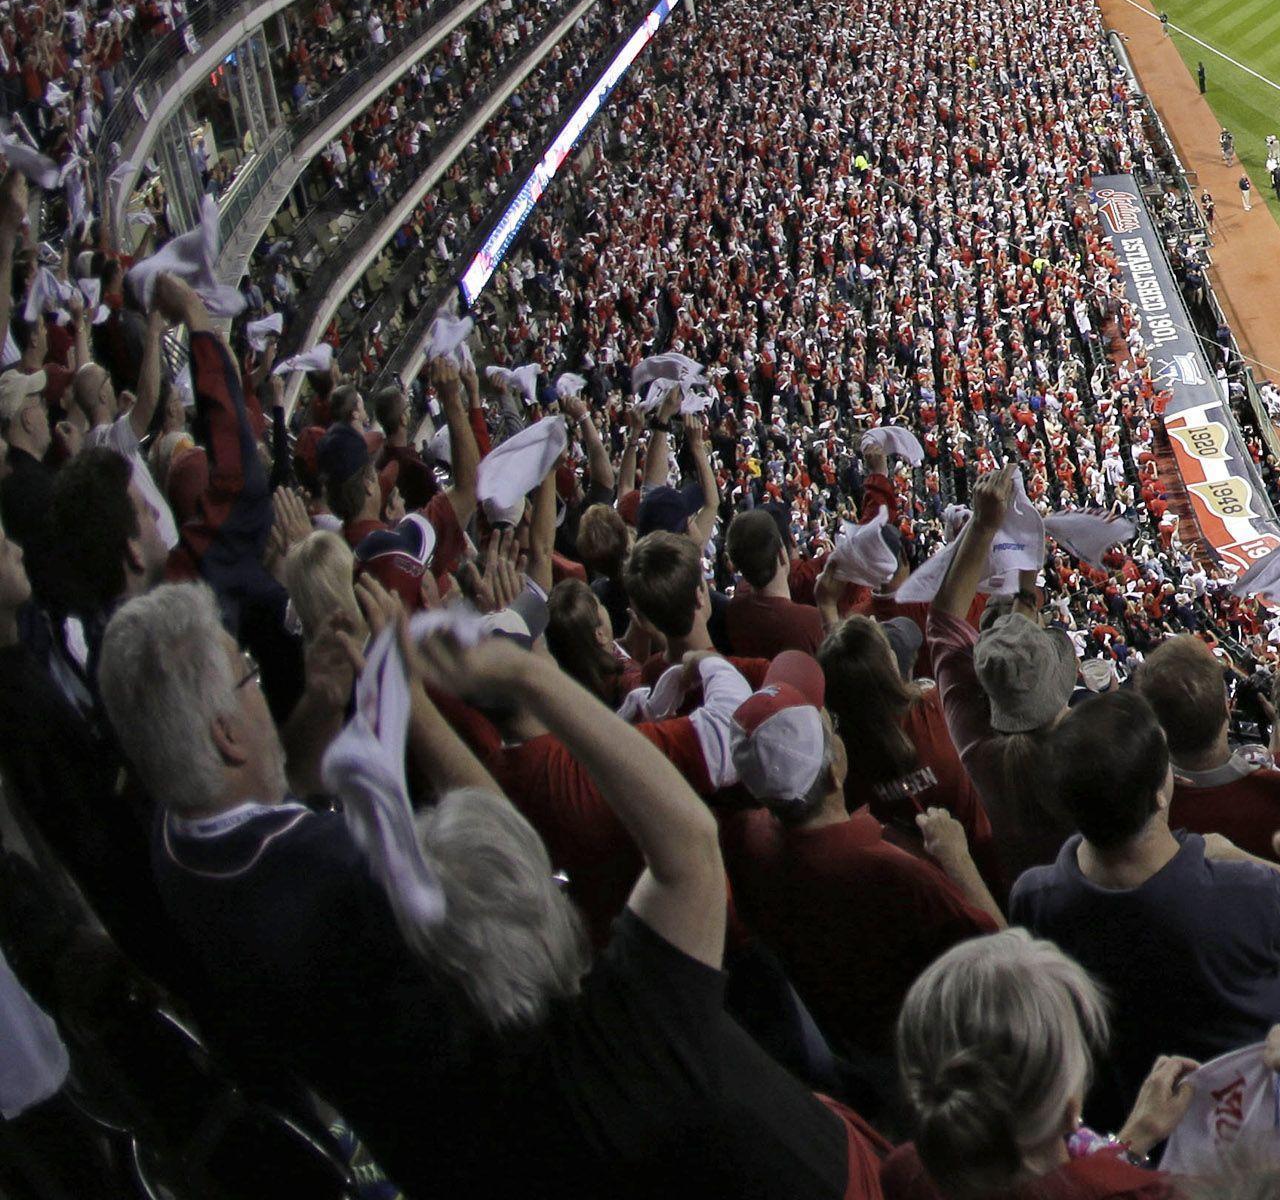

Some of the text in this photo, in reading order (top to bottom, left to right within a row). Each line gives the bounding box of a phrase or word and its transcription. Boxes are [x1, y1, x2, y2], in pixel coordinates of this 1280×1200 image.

[1096, 187, 1142, 234] Indians
[1121, 237, 1167, 312] ESTABLISHED
[1187, 427, 1219, 458] 1920
[1208, 481, 1243, 515] 1948
[1239, 540, 1273, 559] 19
